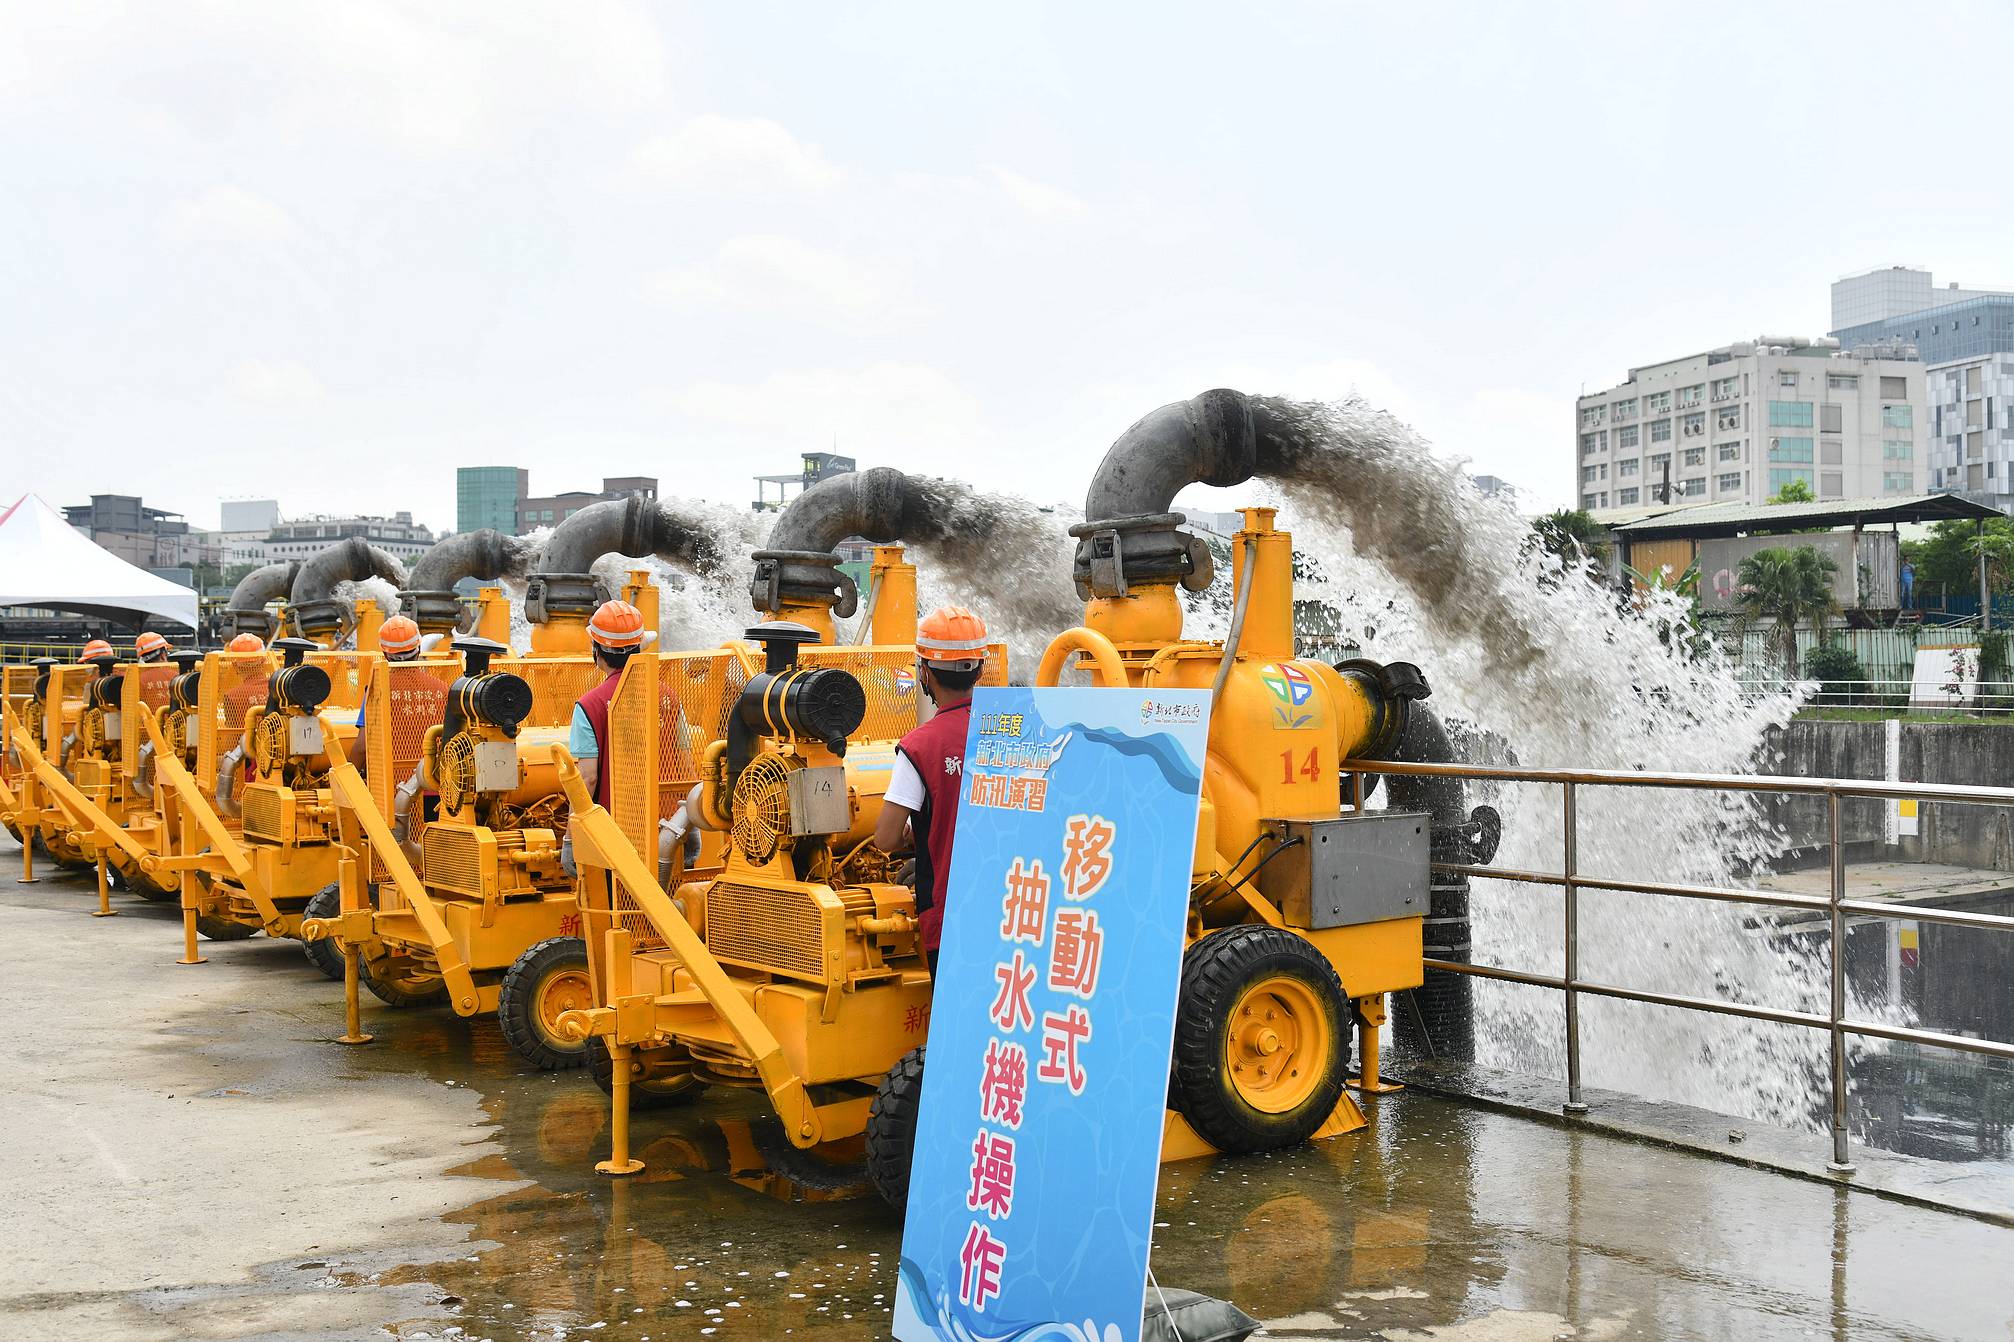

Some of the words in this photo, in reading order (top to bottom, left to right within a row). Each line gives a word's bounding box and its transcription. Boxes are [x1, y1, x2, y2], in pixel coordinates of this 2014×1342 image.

[979, 712, 1024, 738] 111年度
[1155, 702, 1200, 718] 新北市政府
[944, 756, 962, 776] 新
[976, 740, 1054, 770] 新北市政府
[1280, 746, 1320, 785] 14
[814, 780, 833, 797] 14
[969, 772, 1048, 812] 防汛演習
[559, 913, 581, 937] 新
[1038, 815, 1115, 1094] 移動式
[904, 1003, 930, 1036] 新
[959, 860, 1050, 1310] 抽水機操作
